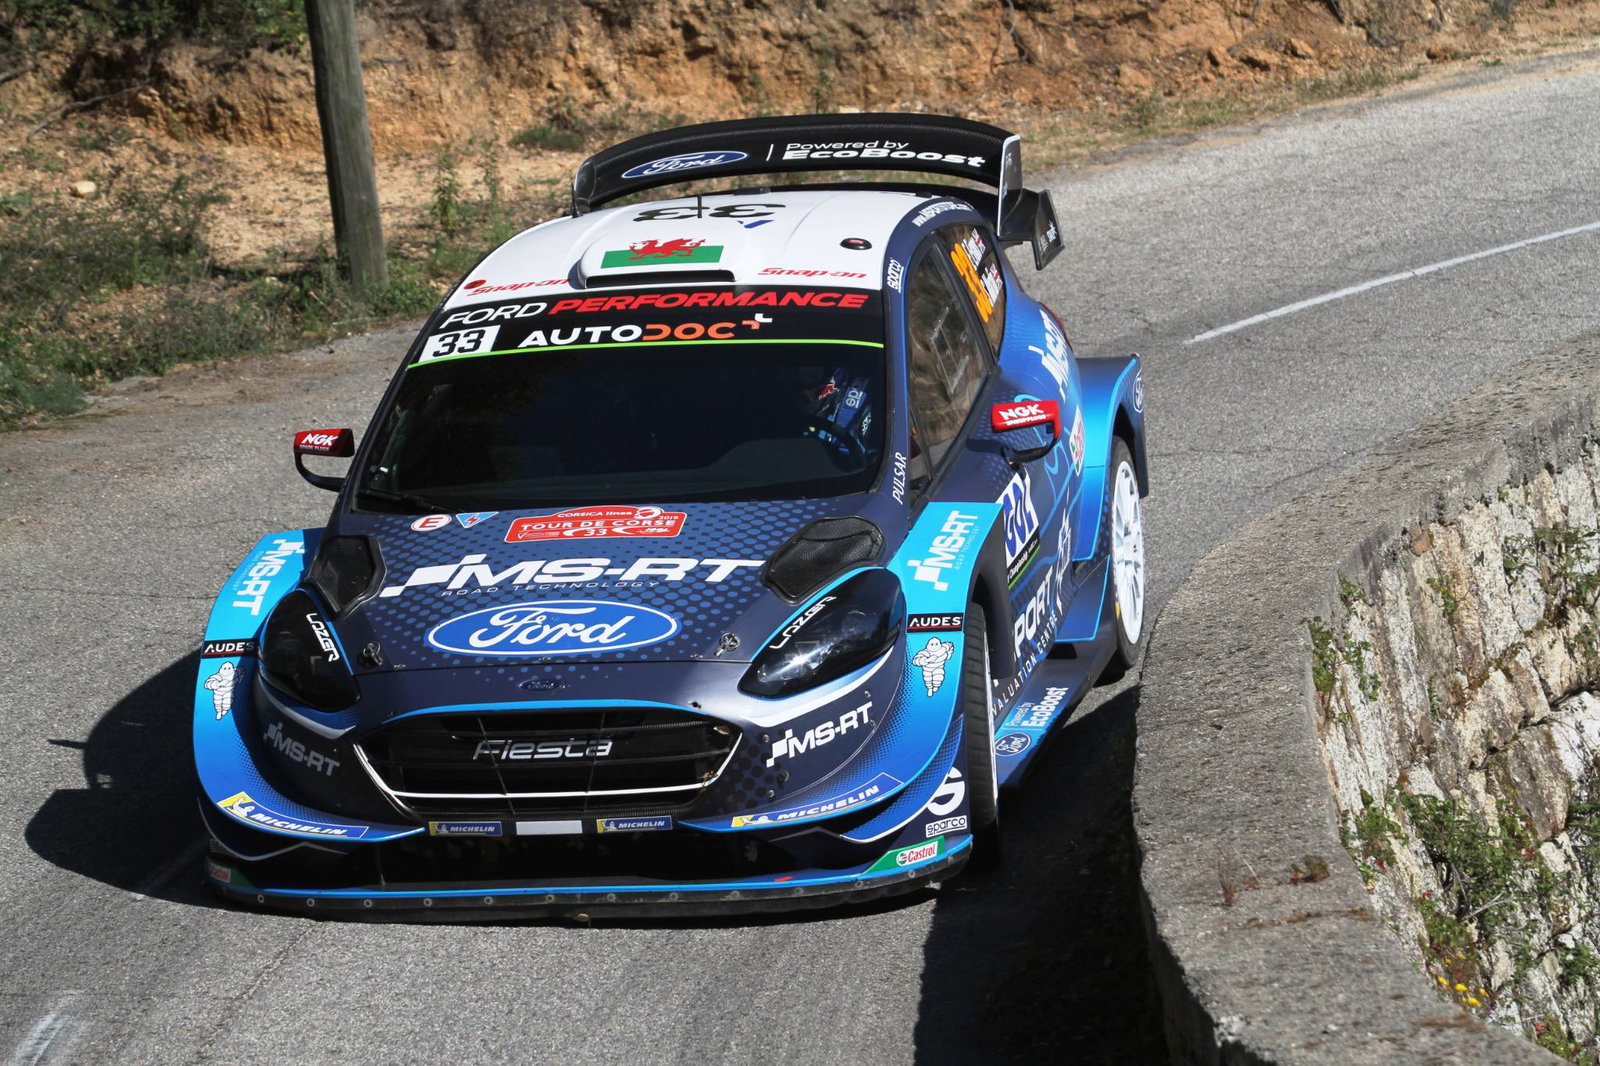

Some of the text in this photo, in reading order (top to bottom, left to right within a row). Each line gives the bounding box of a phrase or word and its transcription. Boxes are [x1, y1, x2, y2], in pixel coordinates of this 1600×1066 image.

[787, 141, 909, 150] Powered by
[643, 154, 725, 175] Ford
[782, 148, 985, 167] EcoBoost
[757, 268, 867, 279] Snap-on
[467, 279, 570, 296] Snap-on
[439, 291, 869, 329] FORD PERFORMANCE
[432, 329, 486, 358] 33
[517, 321, 737, 348] AUTODOC
[999, 404, 1044, 420] NGK
[301, 433, 339, 446] NGK
[892, 452, 907, 504] PULSAR
[419, 517, 442, 528] E
[521, 522, 572, 531] TOUR
[584, 528, 606, 537] 33
[921, 510, 978, 569] MS-RT
[441, 581, 660, 597] ROAD TECHNOLOGY
[770, 596, 836, 649] LAZER
[909, 617, 961, 628] AUDES
[1013, 565, 1053, 661] PORT
[306, 613, 340, 662] LAZER
[469, 607, 635, 648] Ford
[1037, 609, 1058, 654] CENTRE
[204, 641, 255, 653] AUDES
[472, 738, 613, 760] Fiesta
[777, 785, 880, 820] MICHELIN
[250, 812, 348, 836] MICHELIN
[618, 820, 665, 829] MICHELIN
[927, 817, 966, 834] sparco
[907, 843, 936, 863] Castrol
